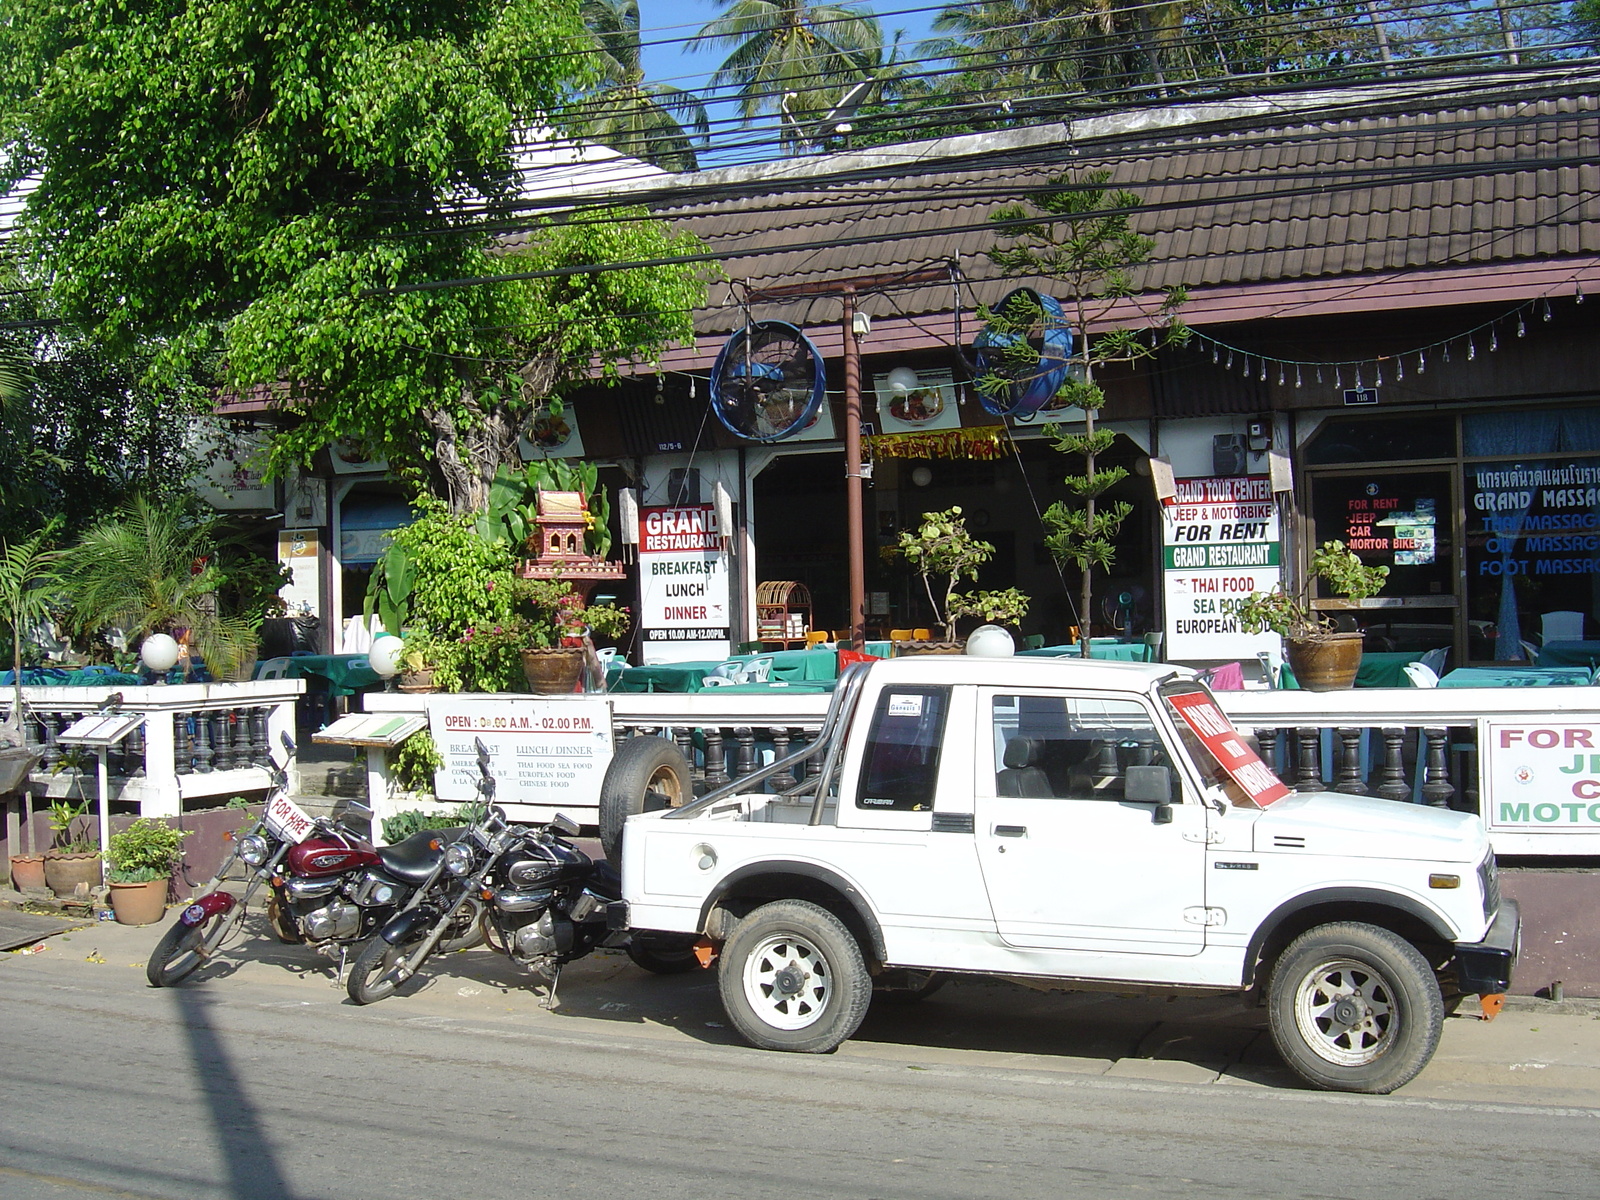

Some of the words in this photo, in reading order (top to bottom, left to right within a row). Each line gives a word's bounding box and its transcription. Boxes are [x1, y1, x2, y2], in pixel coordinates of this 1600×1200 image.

[1206, 481, 1231, 502] TOUR
[1234, 480, 1271, 500] CENTER
[1348, 500, 1368, 510] FOR
[1374, 498, 1399, 508] RENT
[1474, 492, 1531, 512] GRAND
[1543, 488, 1600, 508] MASSA
[1174, 508, 1198, 521] JEEP
[1202, 508, 1208, 520] &
[1212, 505, 1271, 520] MOTORBIKE
[1349, 513, 1376, 523] JEEP
[646, 510, 718, 535] GRAND
[1482, 516, 1517, 532] THAI
[1525, 513, 1600, 530] MASSAG
[1174, 525, 1212, 542] FOR
[1219, 522, 1269, 540] RENT
[1350, 526, 1371, 536] CAR
[646, 534, 720, 550] RESTAURANT
[1350, 538, 1388, 549] MORTOR
[1486, 538, 1512, 553] OIL
[1173, 546, 1206, 567] GRAND
[1209, 545, 1270, 566] RESTAURANT
[652, 561, 717, 575] BREAKFAST
[1480, 560, 1529, 576] FOOT
[666, 583, 704, 597] LUNCH
[1191, 578, 1218, 593] THAI
[1223, 577, 1254, 592] FOOD
[664, 606, 707, 620] DINNER
[1193, 599, 1215, 614] SEA
[1220, 598, 1246, 614] FOO
[1176, 619, 1236, 634] EUROPEAN
[1241, 618, 1271, 634] OD
[649, 630, 667, 639] OPEN
[668, 630, 685, 639] 10.00
[445, 716, 471, 727] OPEN
[510, 717, 532, 728] A.M.
[542, 718, 570, 729] 02.00
[573, 718, 594, 729] P.M.
[1500, 729, 1595, 748] FOR
[450, 744, 500, 753] BREAST
[516, 746, 548, 754] LUNCH
[556, 746, 593, 754] DINNER
[271, 798, 291, 819] FOR
[286, 812, 309, 835] HIRE
